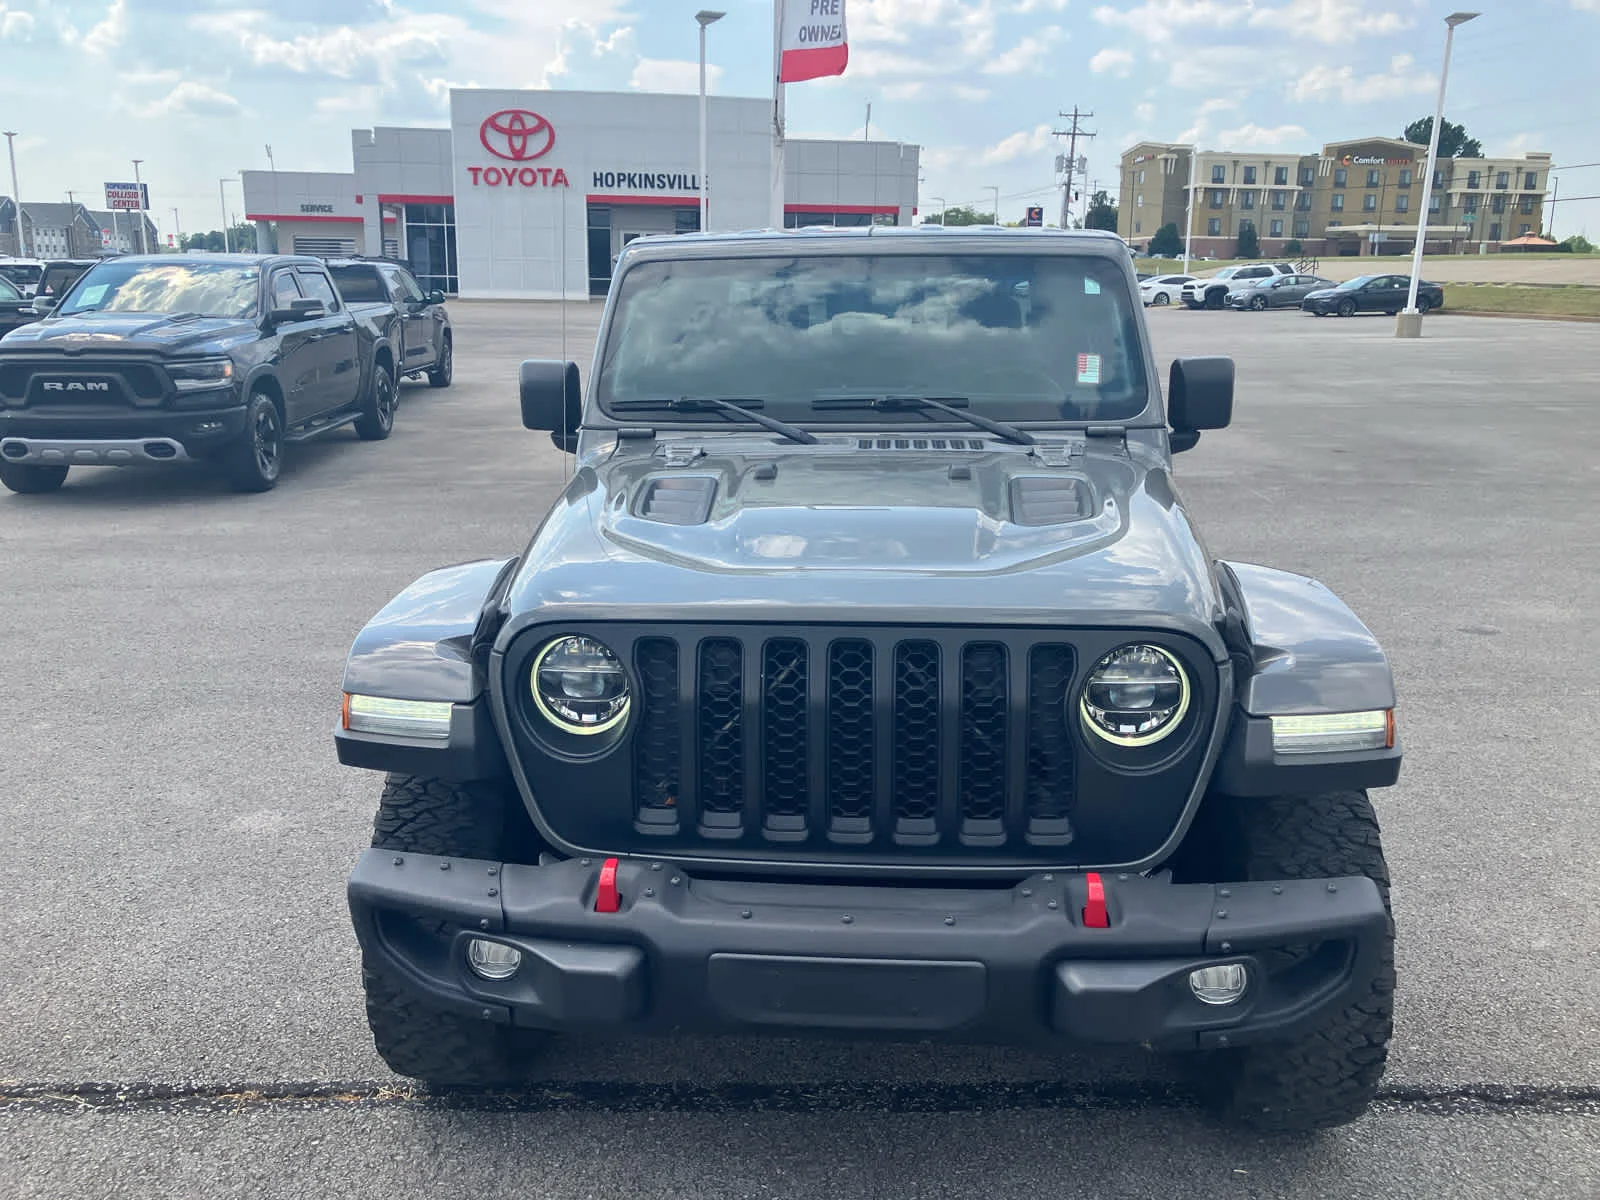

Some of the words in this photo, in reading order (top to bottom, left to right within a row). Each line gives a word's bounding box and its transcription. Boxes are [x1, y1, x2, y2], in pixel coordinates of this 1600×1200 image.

[810, 0, 839, 15] PRE
[1353, 156, 1384, 165] Comfort
[468, 167, 569, 187] TOYOTA
[300, 204, 333, 213] SERVICE
[43, 382, 108, 391] RAM
